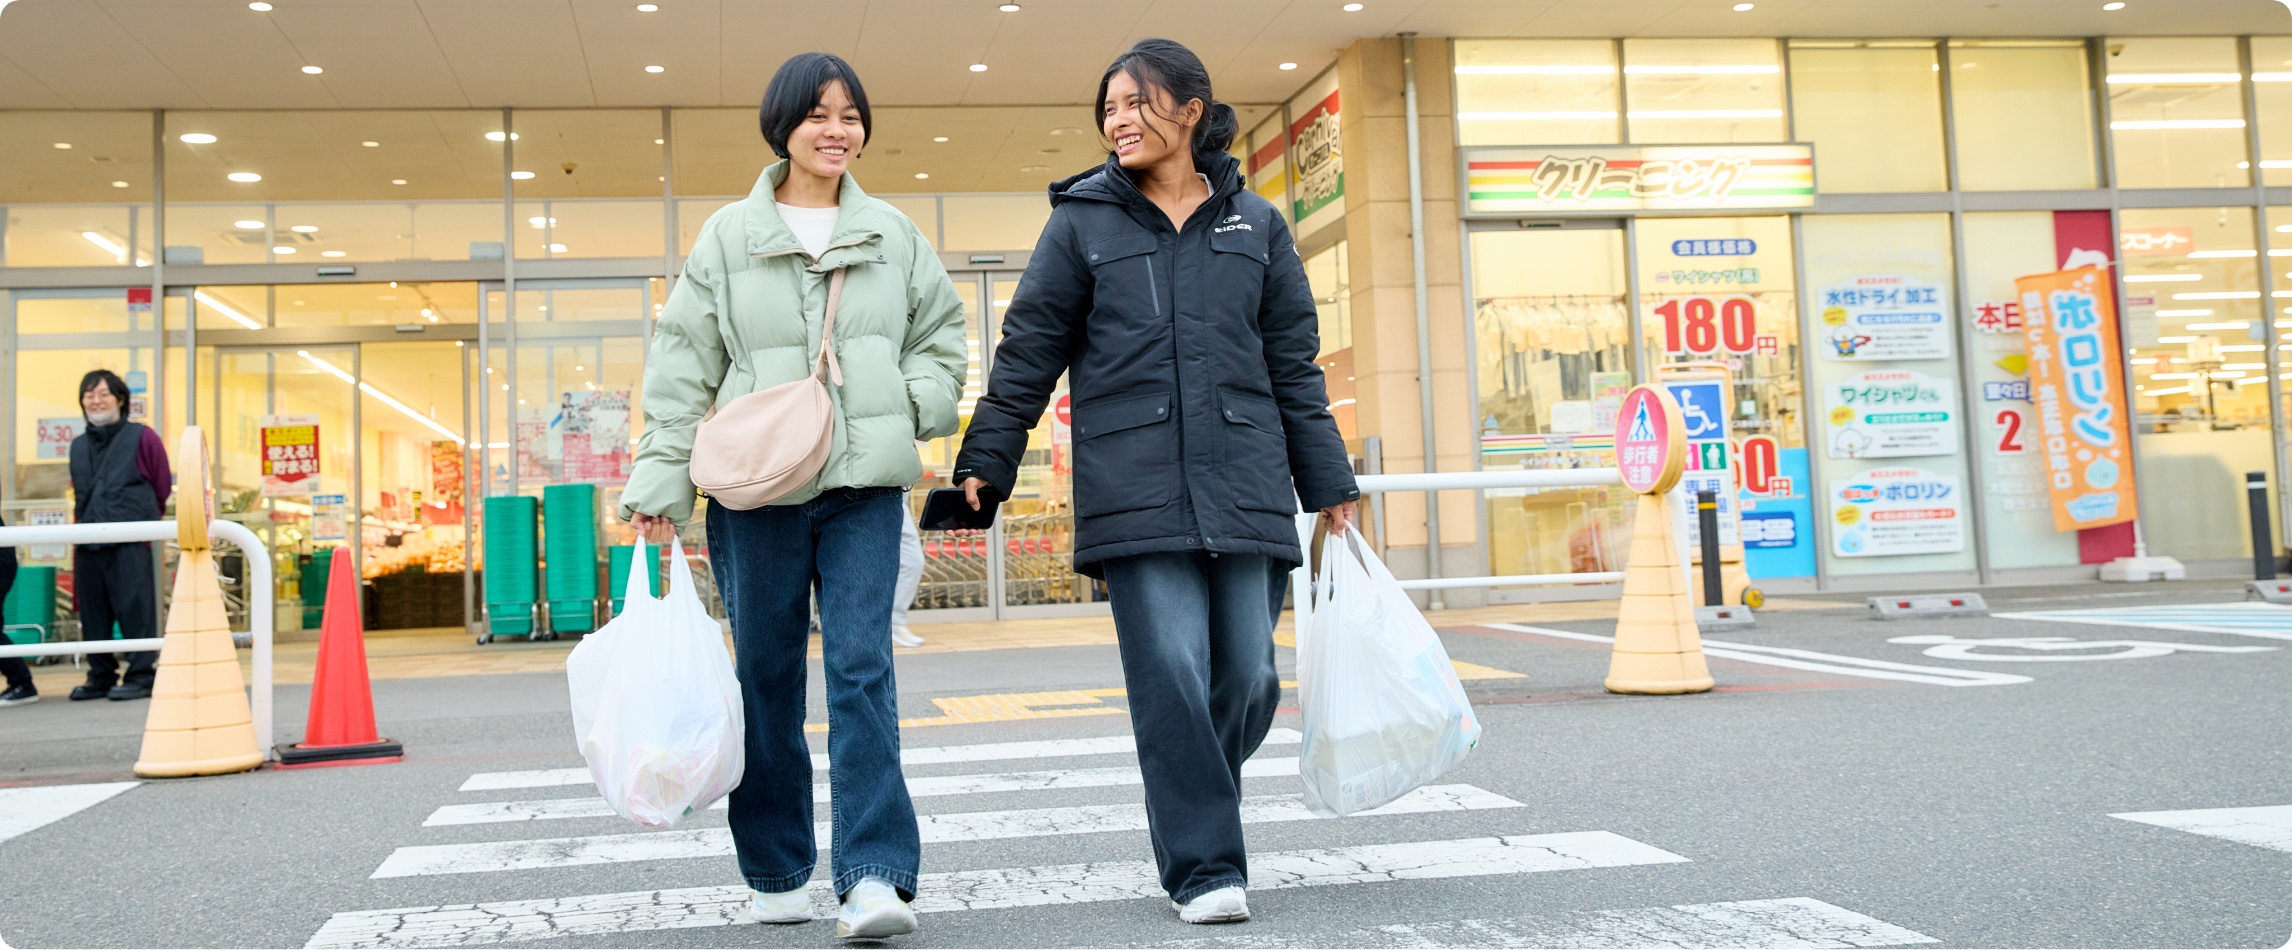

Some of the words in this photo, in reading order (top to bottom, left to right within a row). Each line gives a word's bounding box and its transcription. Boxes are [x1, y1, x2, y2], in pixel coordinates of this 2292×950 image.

[1531, 155, 1751, 202] クリーニング
[1827, 288, 1900, 305] 水性ドライ
[1905, 288, 1937, 303] 加工
[1653, 297, 1778, 356] 180円
[1840, 385, 1940, 404] ワイシャツくん
[1996, 410, 2023, 452] 2
[1623, 446, 1659, 465] 歩行者
[1629, 466, 1652, 484] 注意
[1886, 482, 1952, 500] ポロリン
